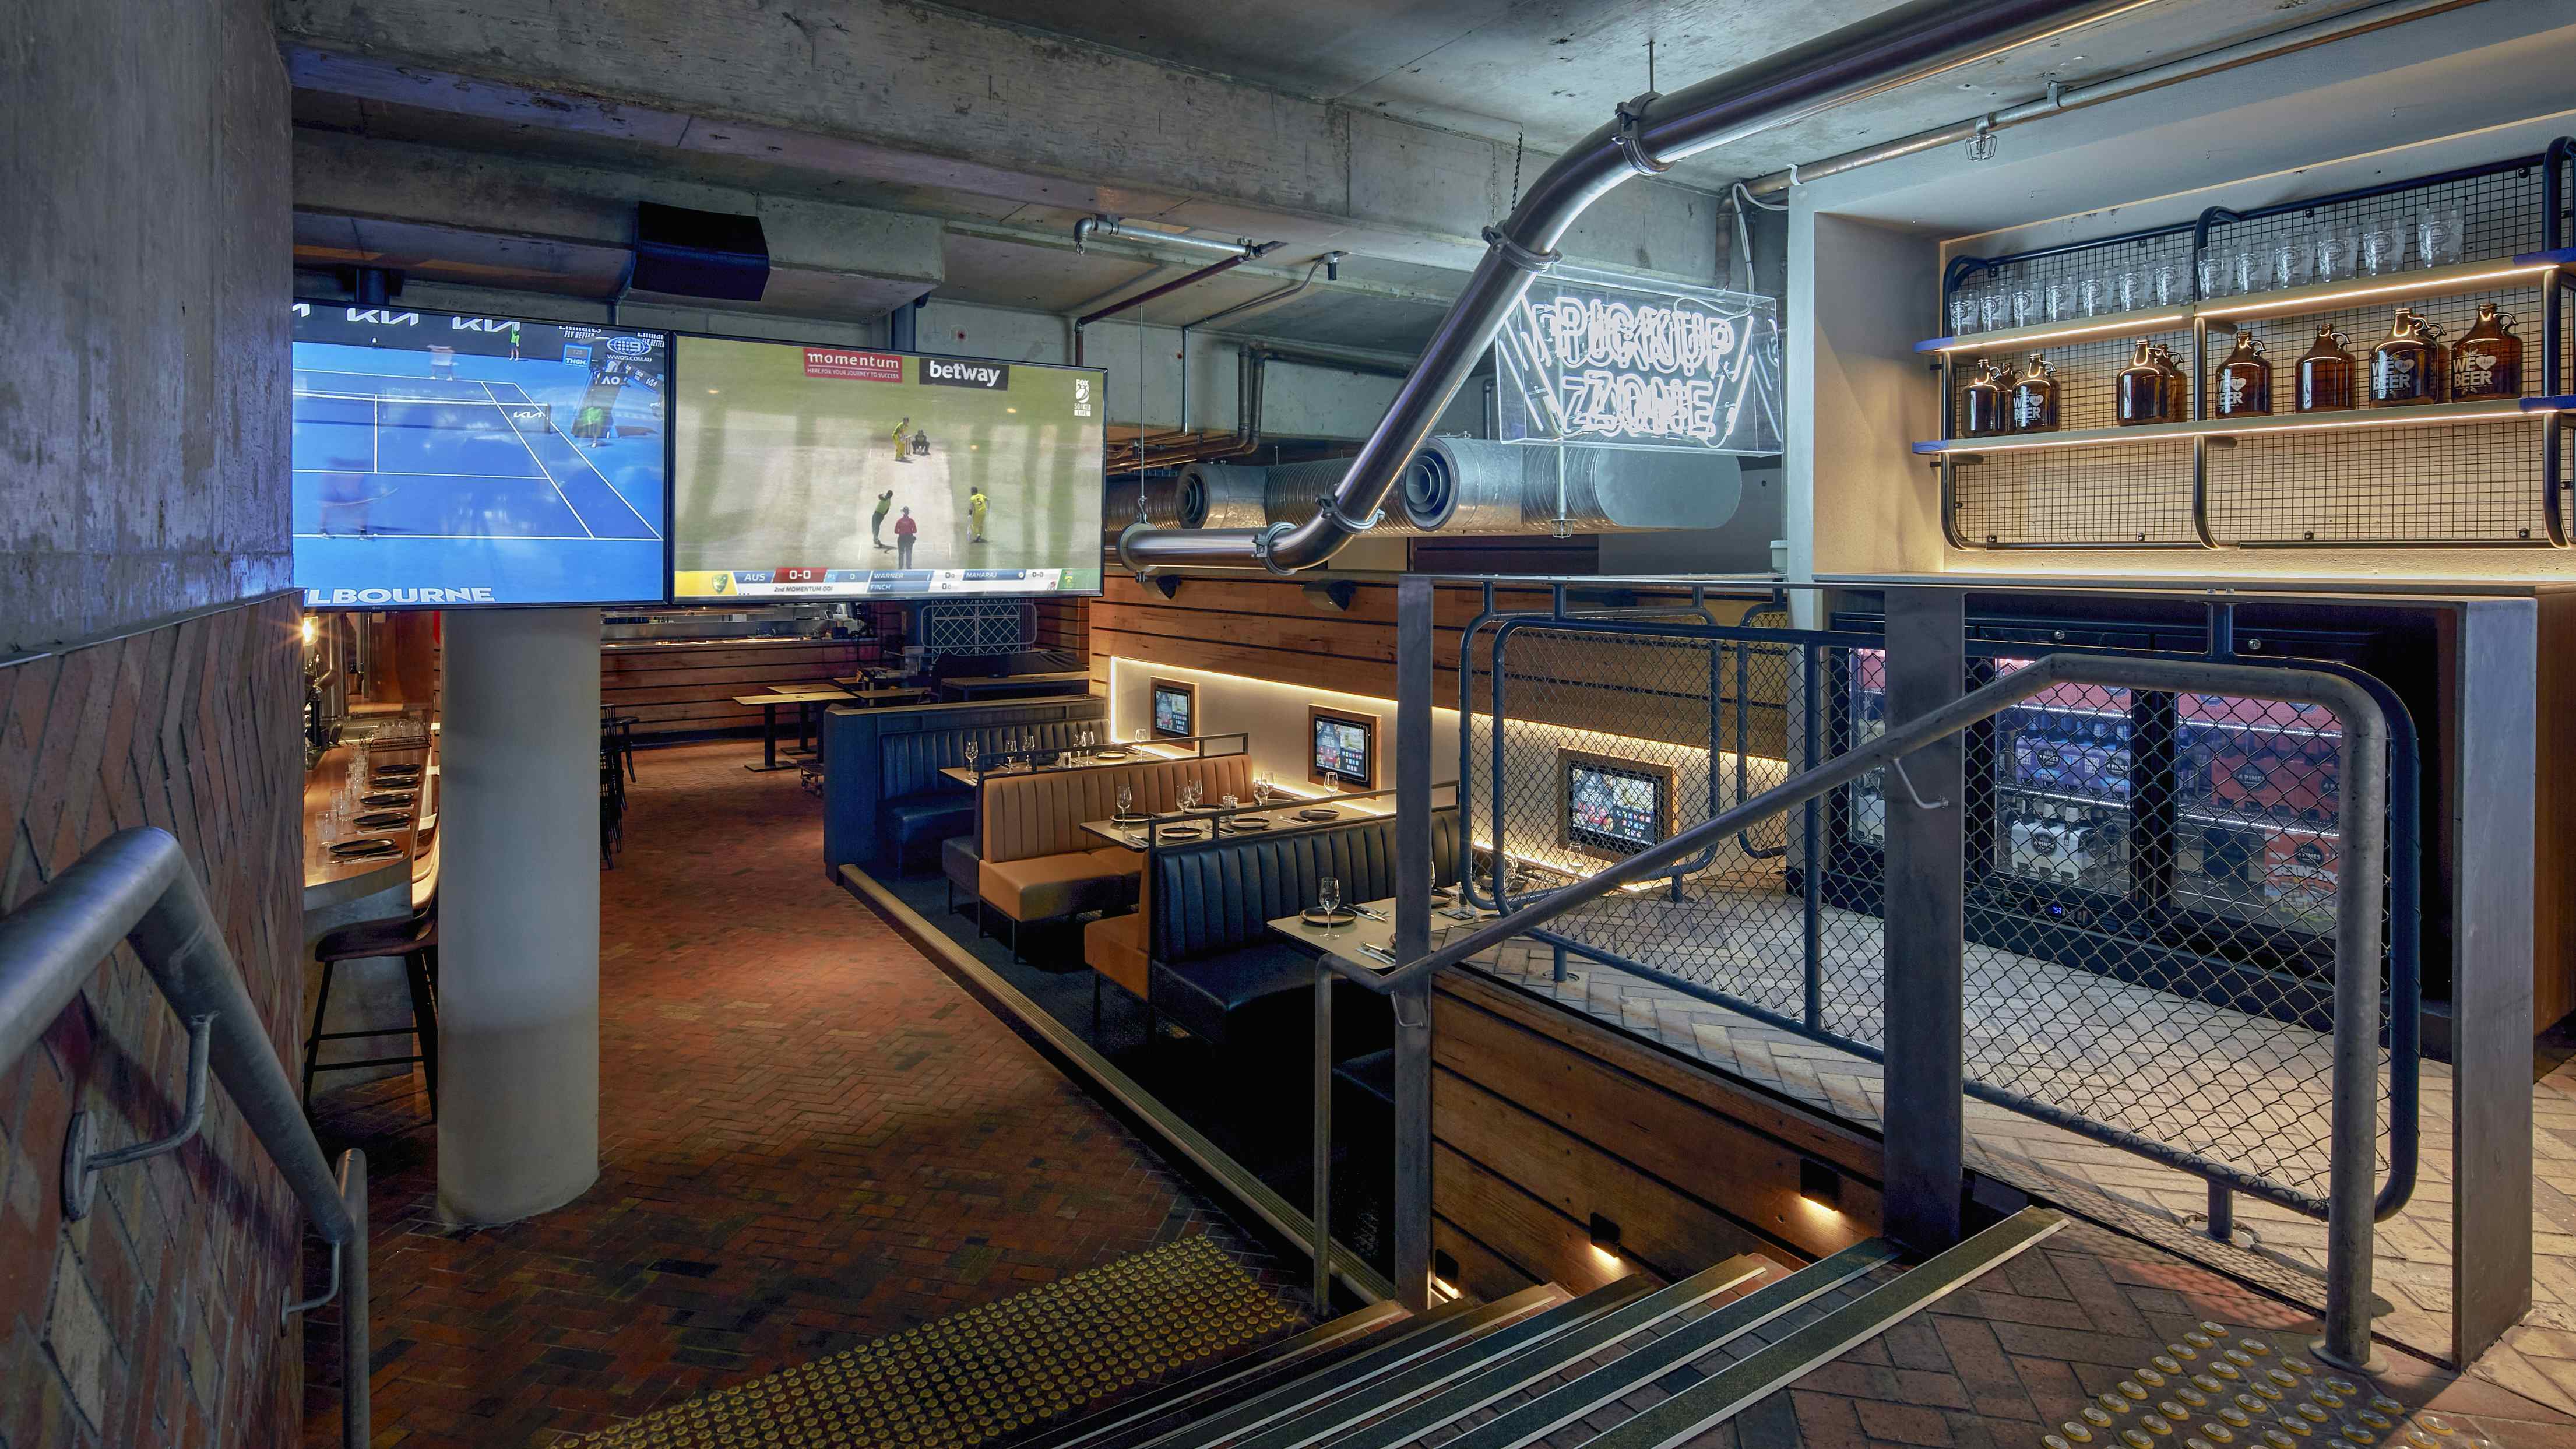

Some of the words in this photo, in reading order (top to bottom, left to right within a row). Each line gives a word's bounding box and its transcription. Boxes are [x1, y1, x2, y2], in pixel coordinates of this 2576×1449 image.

[346, 307, 419, 326] KIA
[452, 316, 520, 332] KIA
[1546, 297, 1734, 376] PICKUP
[807, 353, 899, 369] momentum
[2452, 356, 2476, 374] WE
[930, 360, 1001, 387] betway
[2454, 370, 2493, 388] BEER
[1075, 379, 1089, 387] FOX
[1563, 370, 1716, 437] ZONE
[744, 572, 765, 582] AUS
[789, 569, 811, 579] 0-0
[305, 587, 495, 604] LBOURNE
